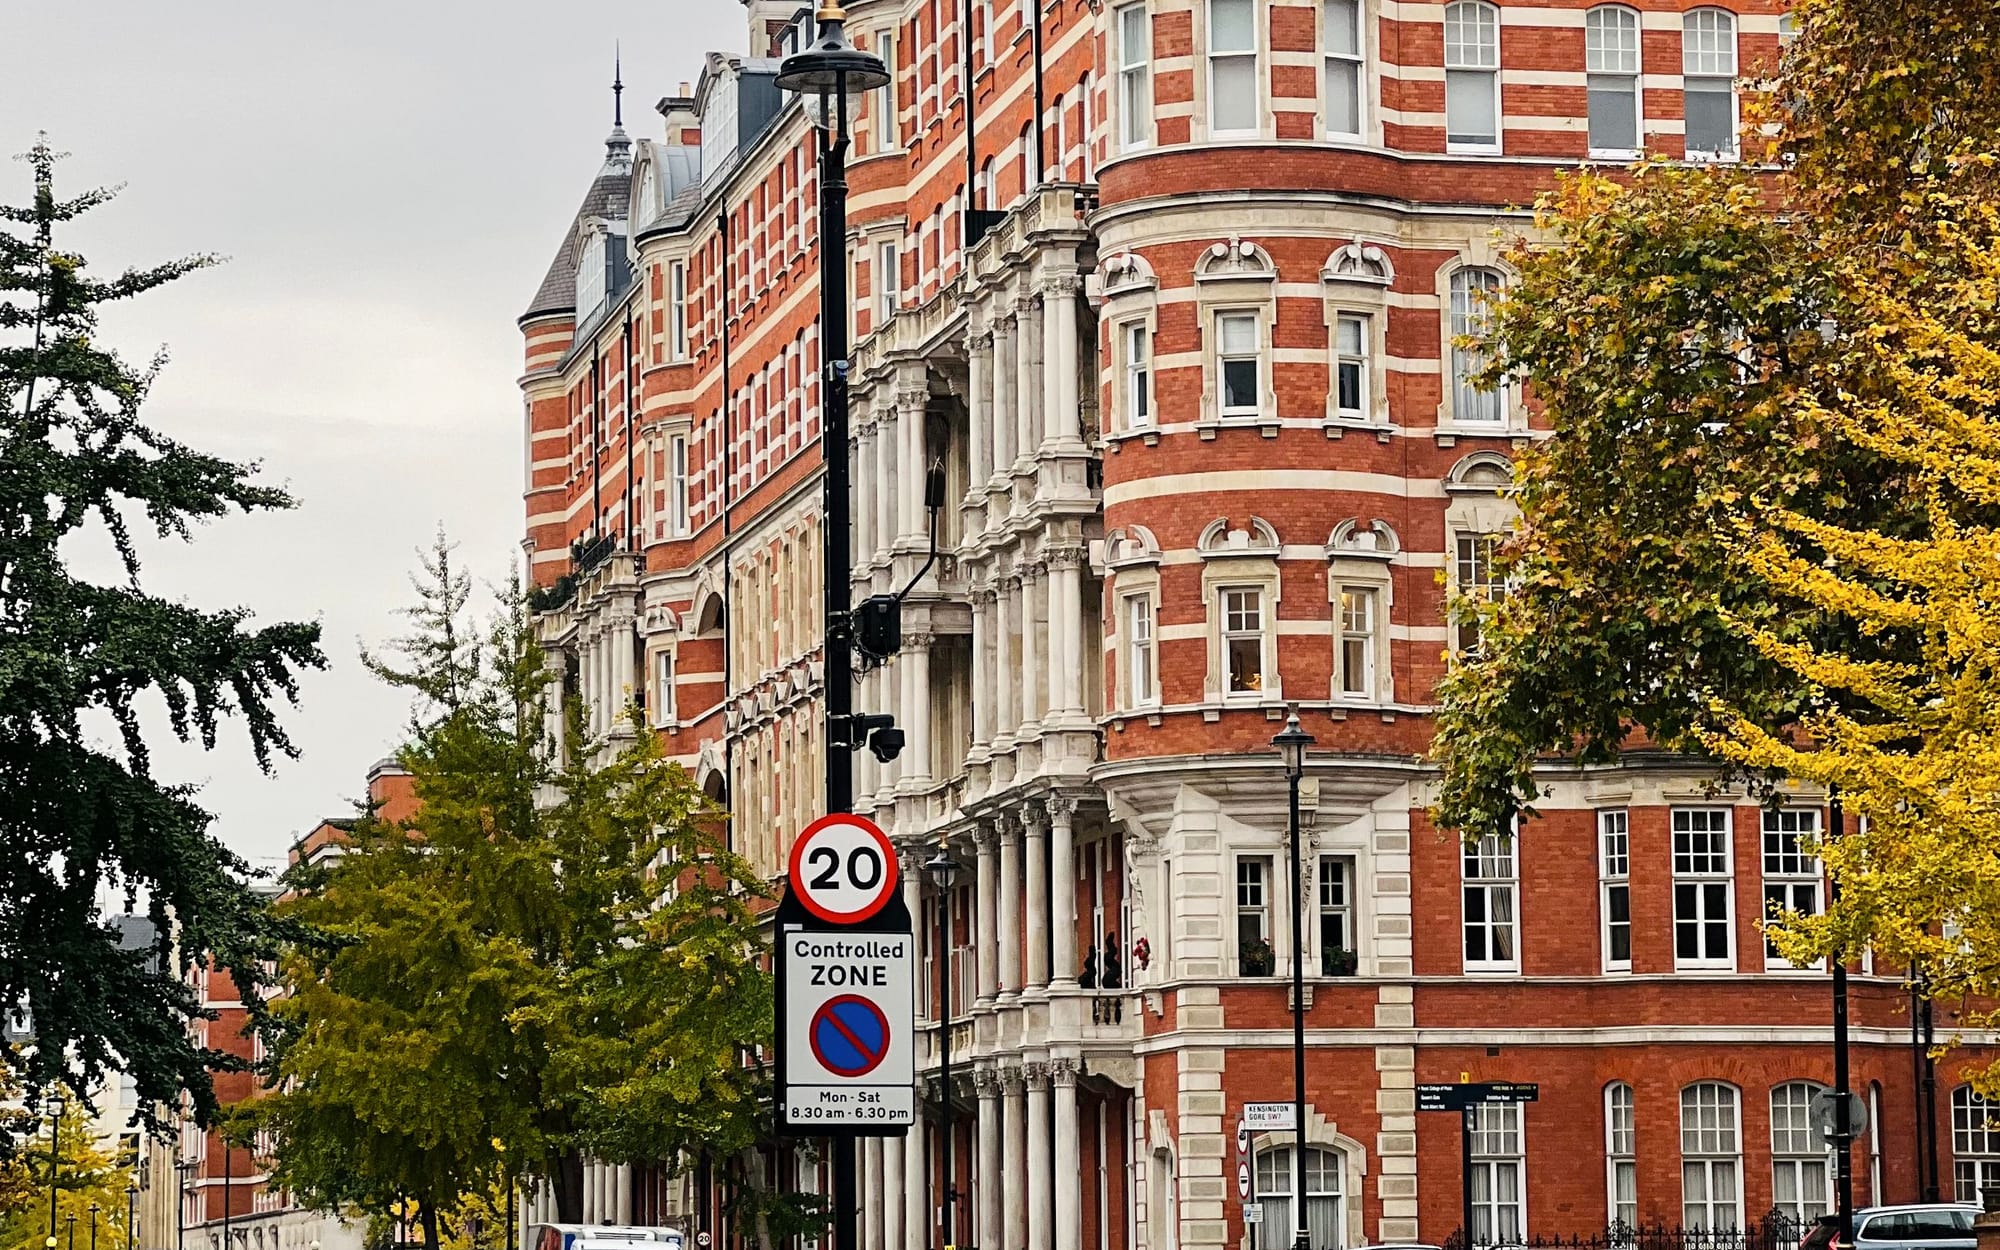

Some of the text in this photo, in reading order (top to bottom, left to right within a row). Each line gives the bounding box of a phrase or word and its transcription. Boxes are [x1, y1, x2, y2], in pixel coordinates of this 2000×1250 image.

[808, 846, 882, 890] 20
[795, 940, 903, 958] Controlled
[811, 965, 887, 986] ZONE
[820, 1091, 847, 1102] Mon
[858, 1091, 880, 1102] Sat
[791, 1107, 823, 1118] 8.30
[825, 1109, 845, 1118] am
[855, 1107, 886, 1118] 6.30
[889, 1109, 908, 1120] pm
